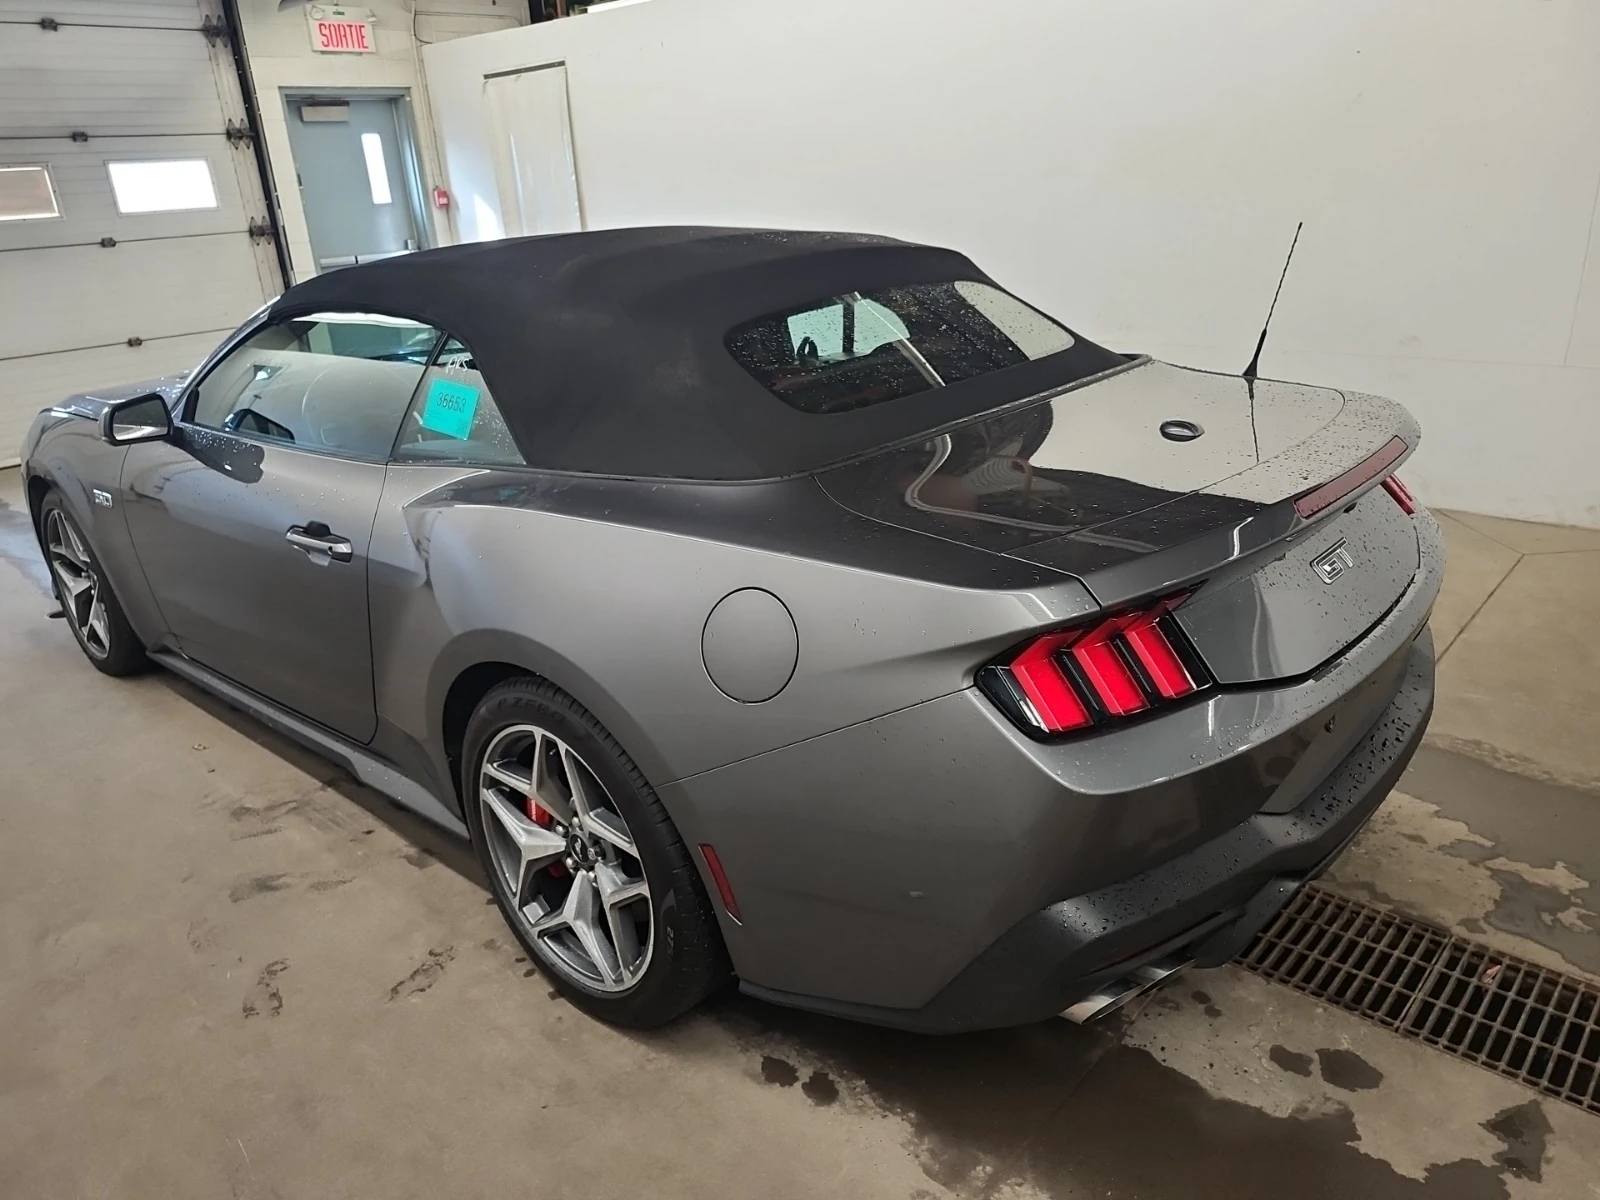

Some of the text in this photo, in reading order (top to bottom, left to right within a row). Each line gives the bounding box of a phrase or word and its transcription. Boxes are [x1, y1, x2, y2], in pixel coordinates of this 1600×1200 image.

[319, 23, 369, 49] SORTIE
[437, 392, 466, 413] 36653
[1310, 537, 1354, 586] GT
